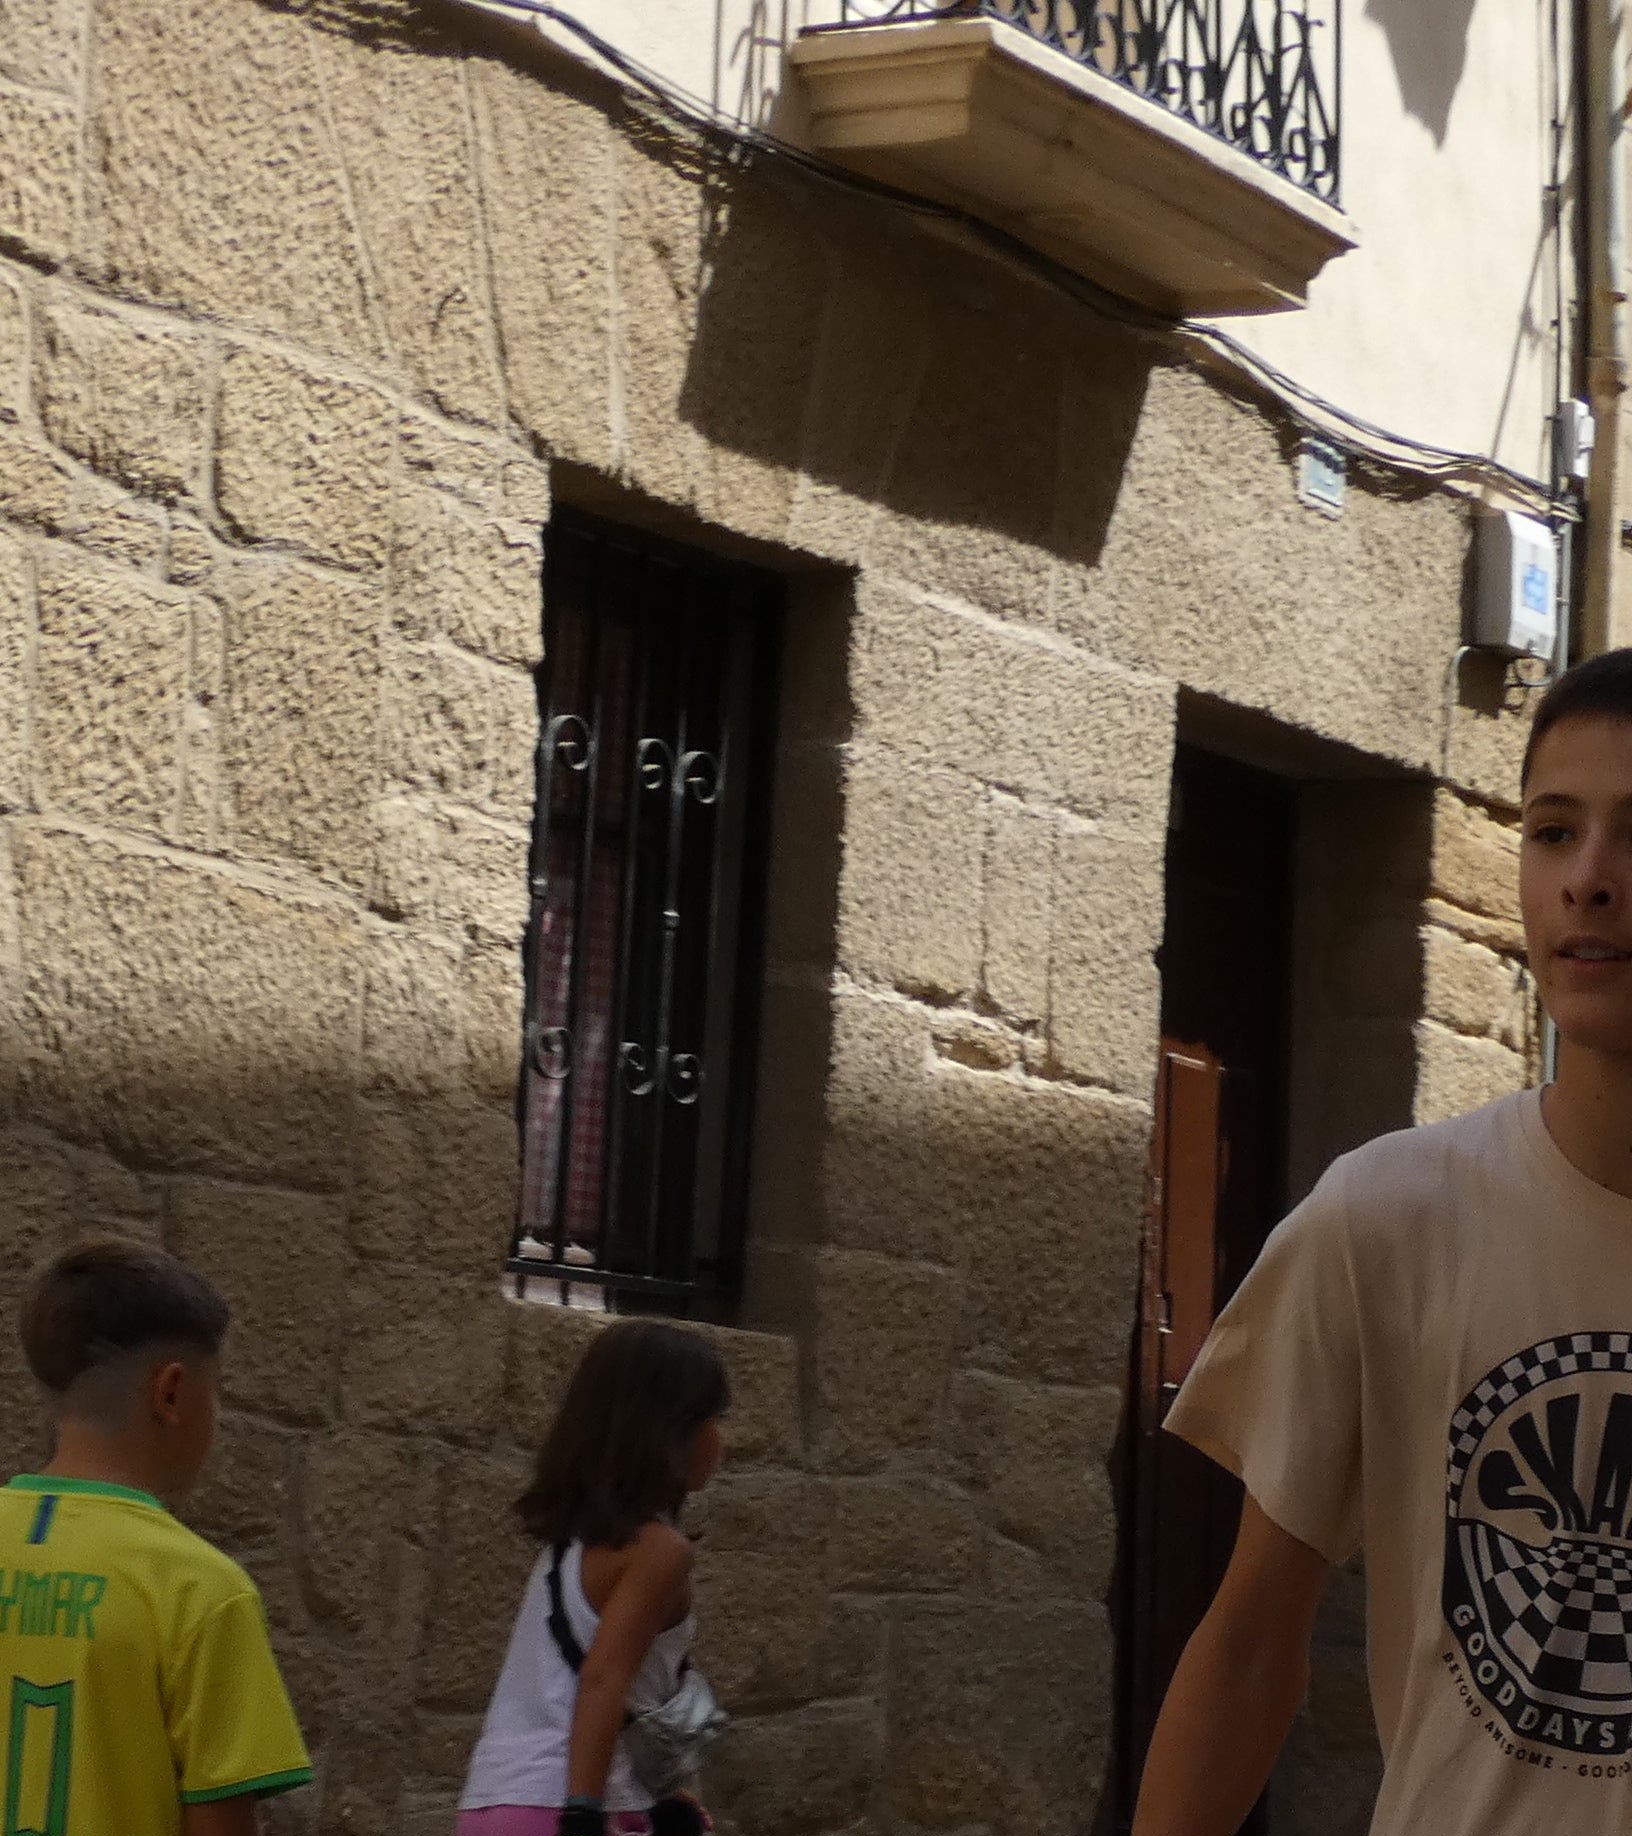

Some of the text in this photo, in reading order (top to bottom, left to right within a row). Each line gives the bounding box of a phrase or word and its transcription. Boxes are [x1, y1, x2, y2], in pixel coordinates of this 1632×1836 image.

[1442, 1651, 1482, 1718] BEYOND
[1578, 1764, 1621, 1779] GOO
[1452, 1603, 1517, 1708] GOOD
[1516, 1703, 1617, 1749] DAYS
